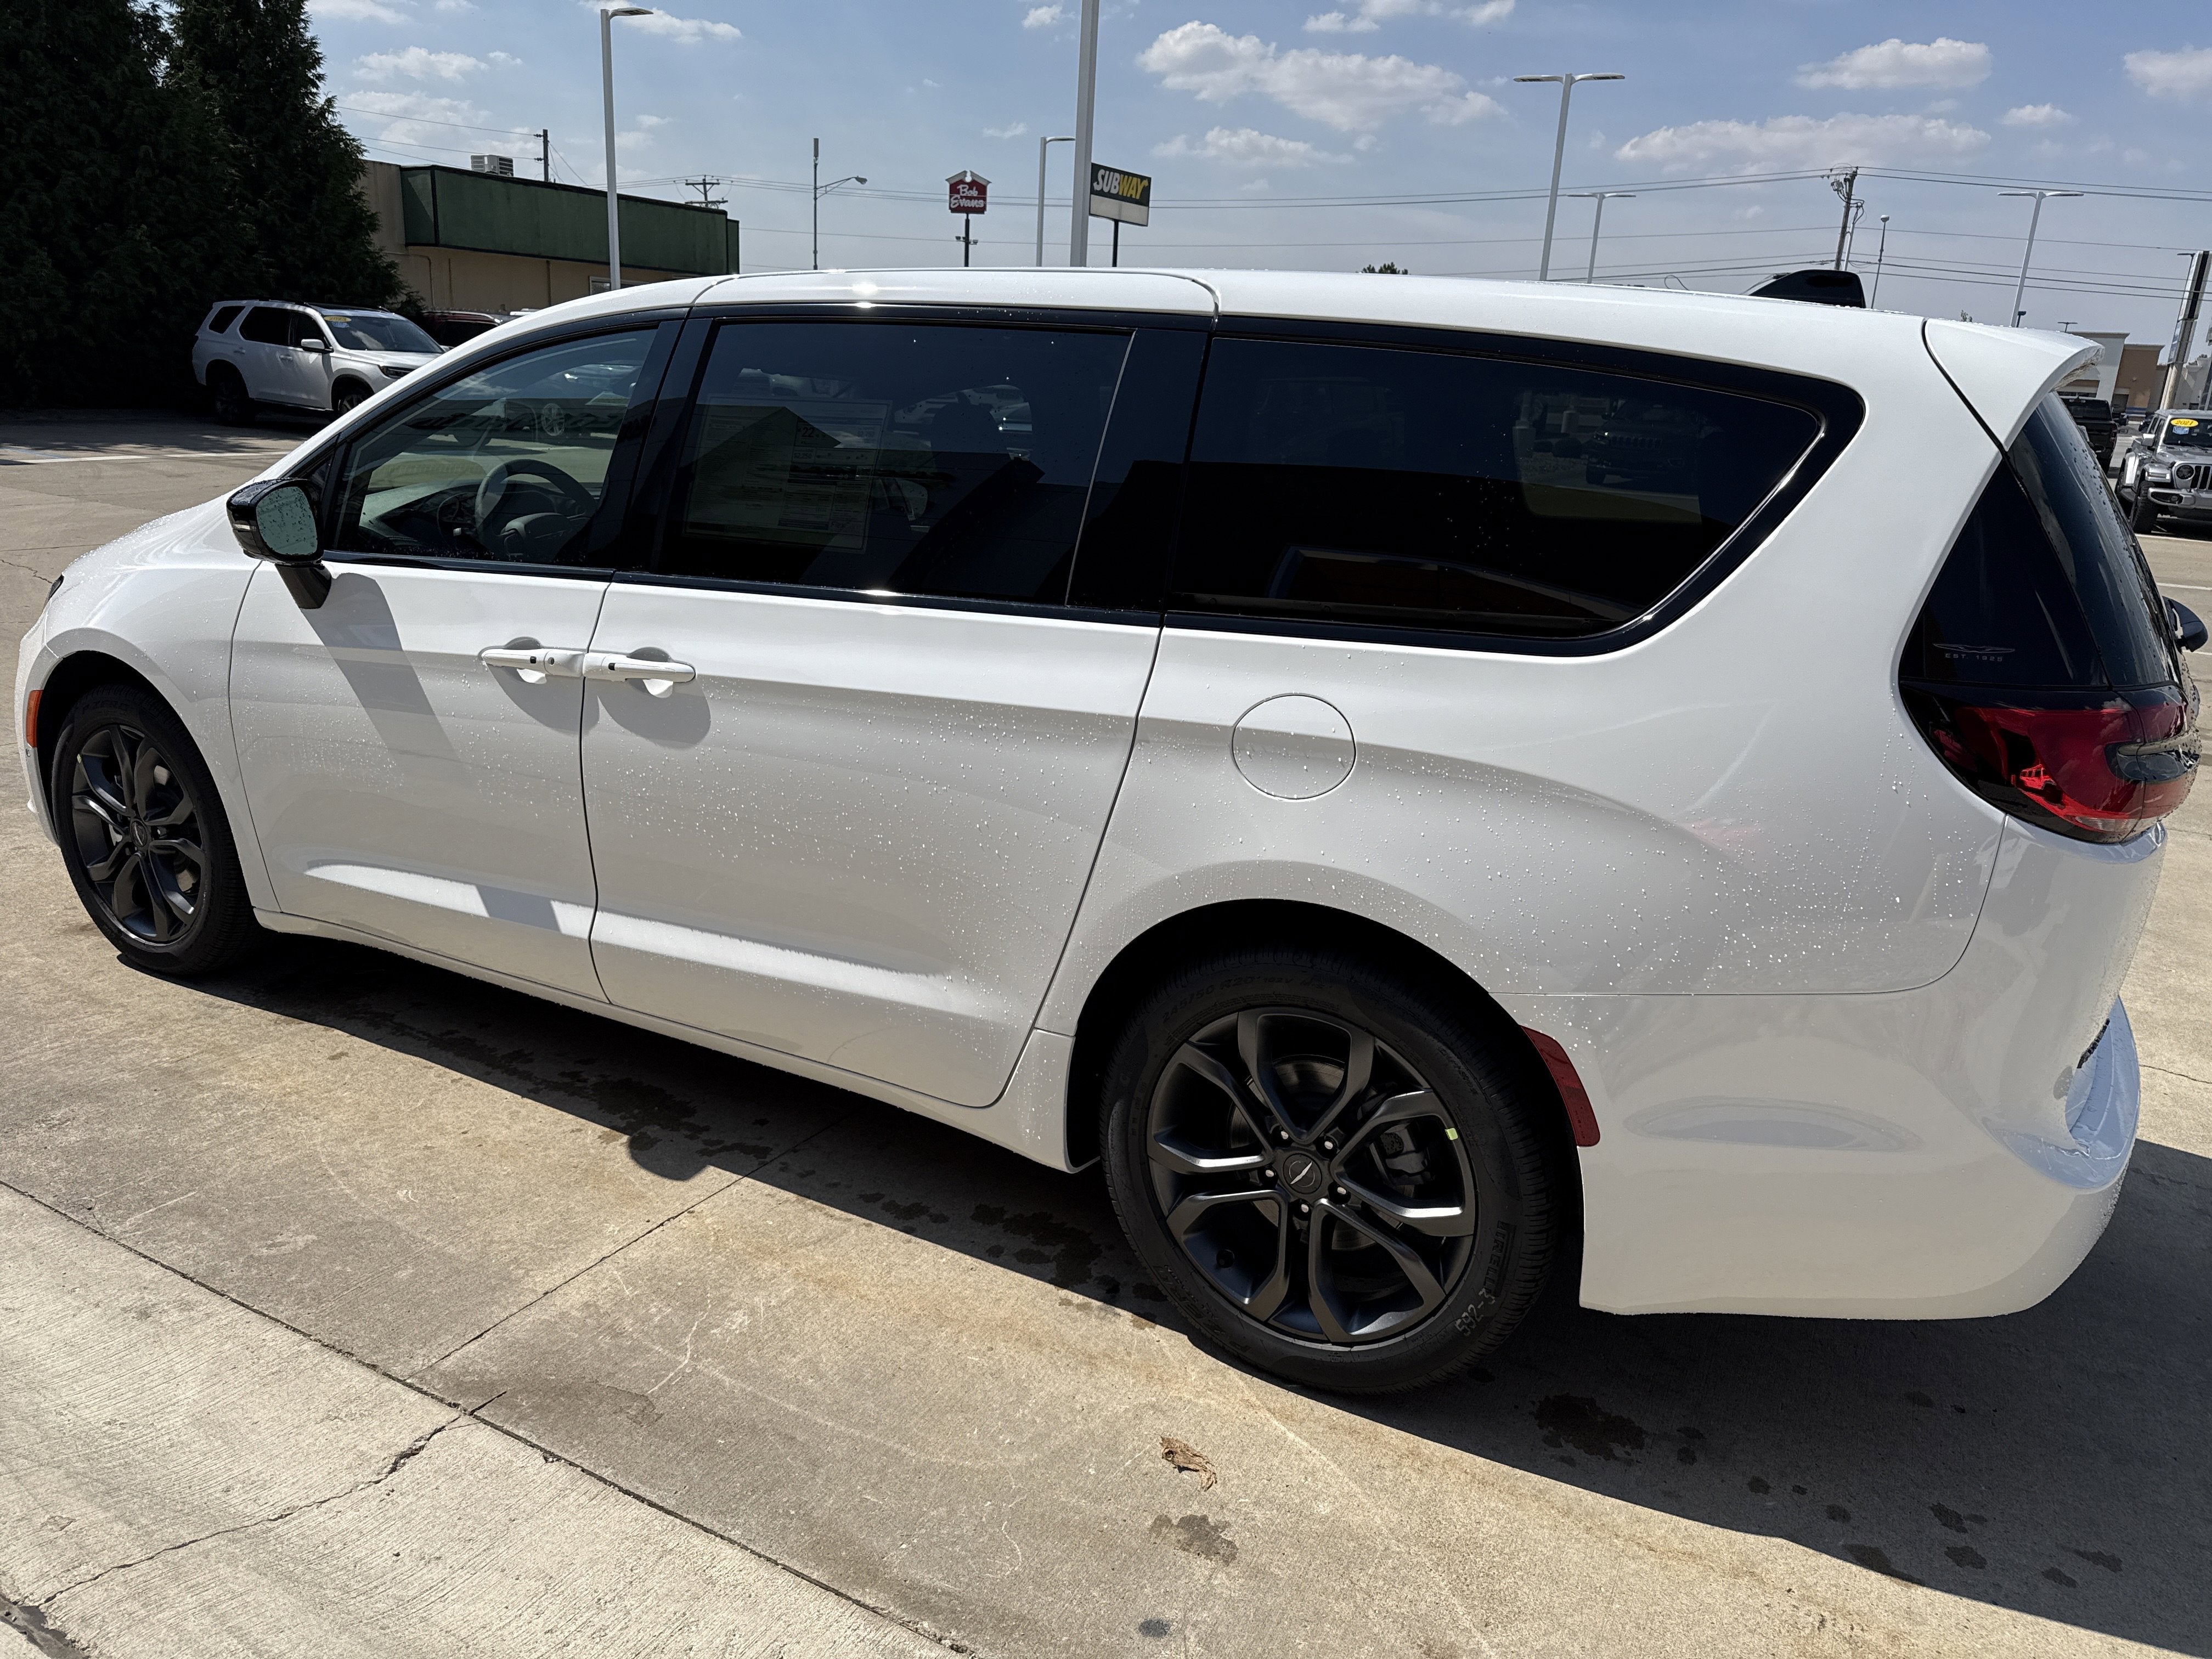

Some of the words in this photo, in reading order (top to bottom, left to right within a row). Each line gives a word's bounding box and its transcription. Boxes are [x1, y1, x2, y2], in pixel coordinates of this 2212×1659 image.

[956, 184, 978, 196] Bob
[1092, 168, 1149, 200] SUBWAY
[950, 195, 984, 208] Evans
